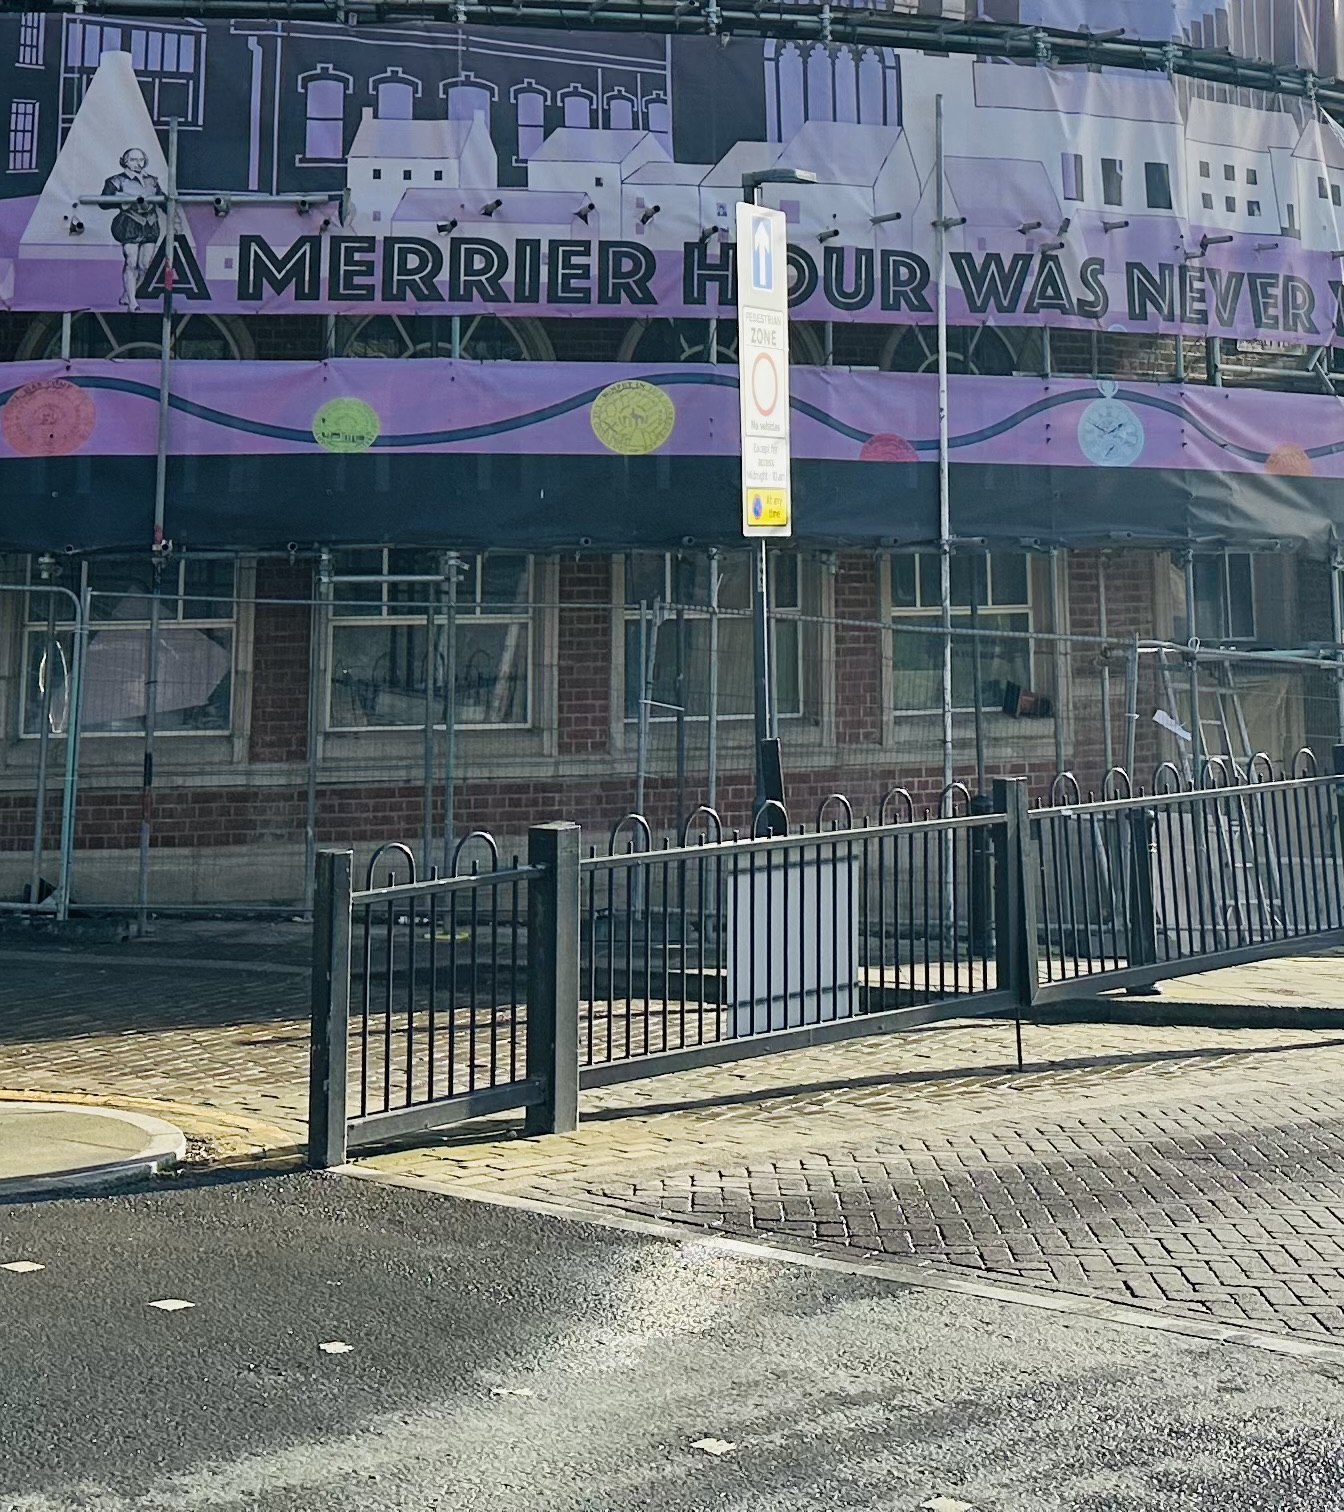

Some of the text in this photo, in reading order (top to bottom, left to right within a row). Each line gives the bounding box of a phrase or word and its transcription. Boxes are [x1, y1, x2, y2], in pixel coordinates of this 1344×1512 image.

[137, 234, 212, 301] A
[237, 234, 659, 306] MERRIER
[949, 251, 1110, 319] WAS
[1125, 261, 1319, 335] NEVER
[751, 327, 777, 346] ZONE
